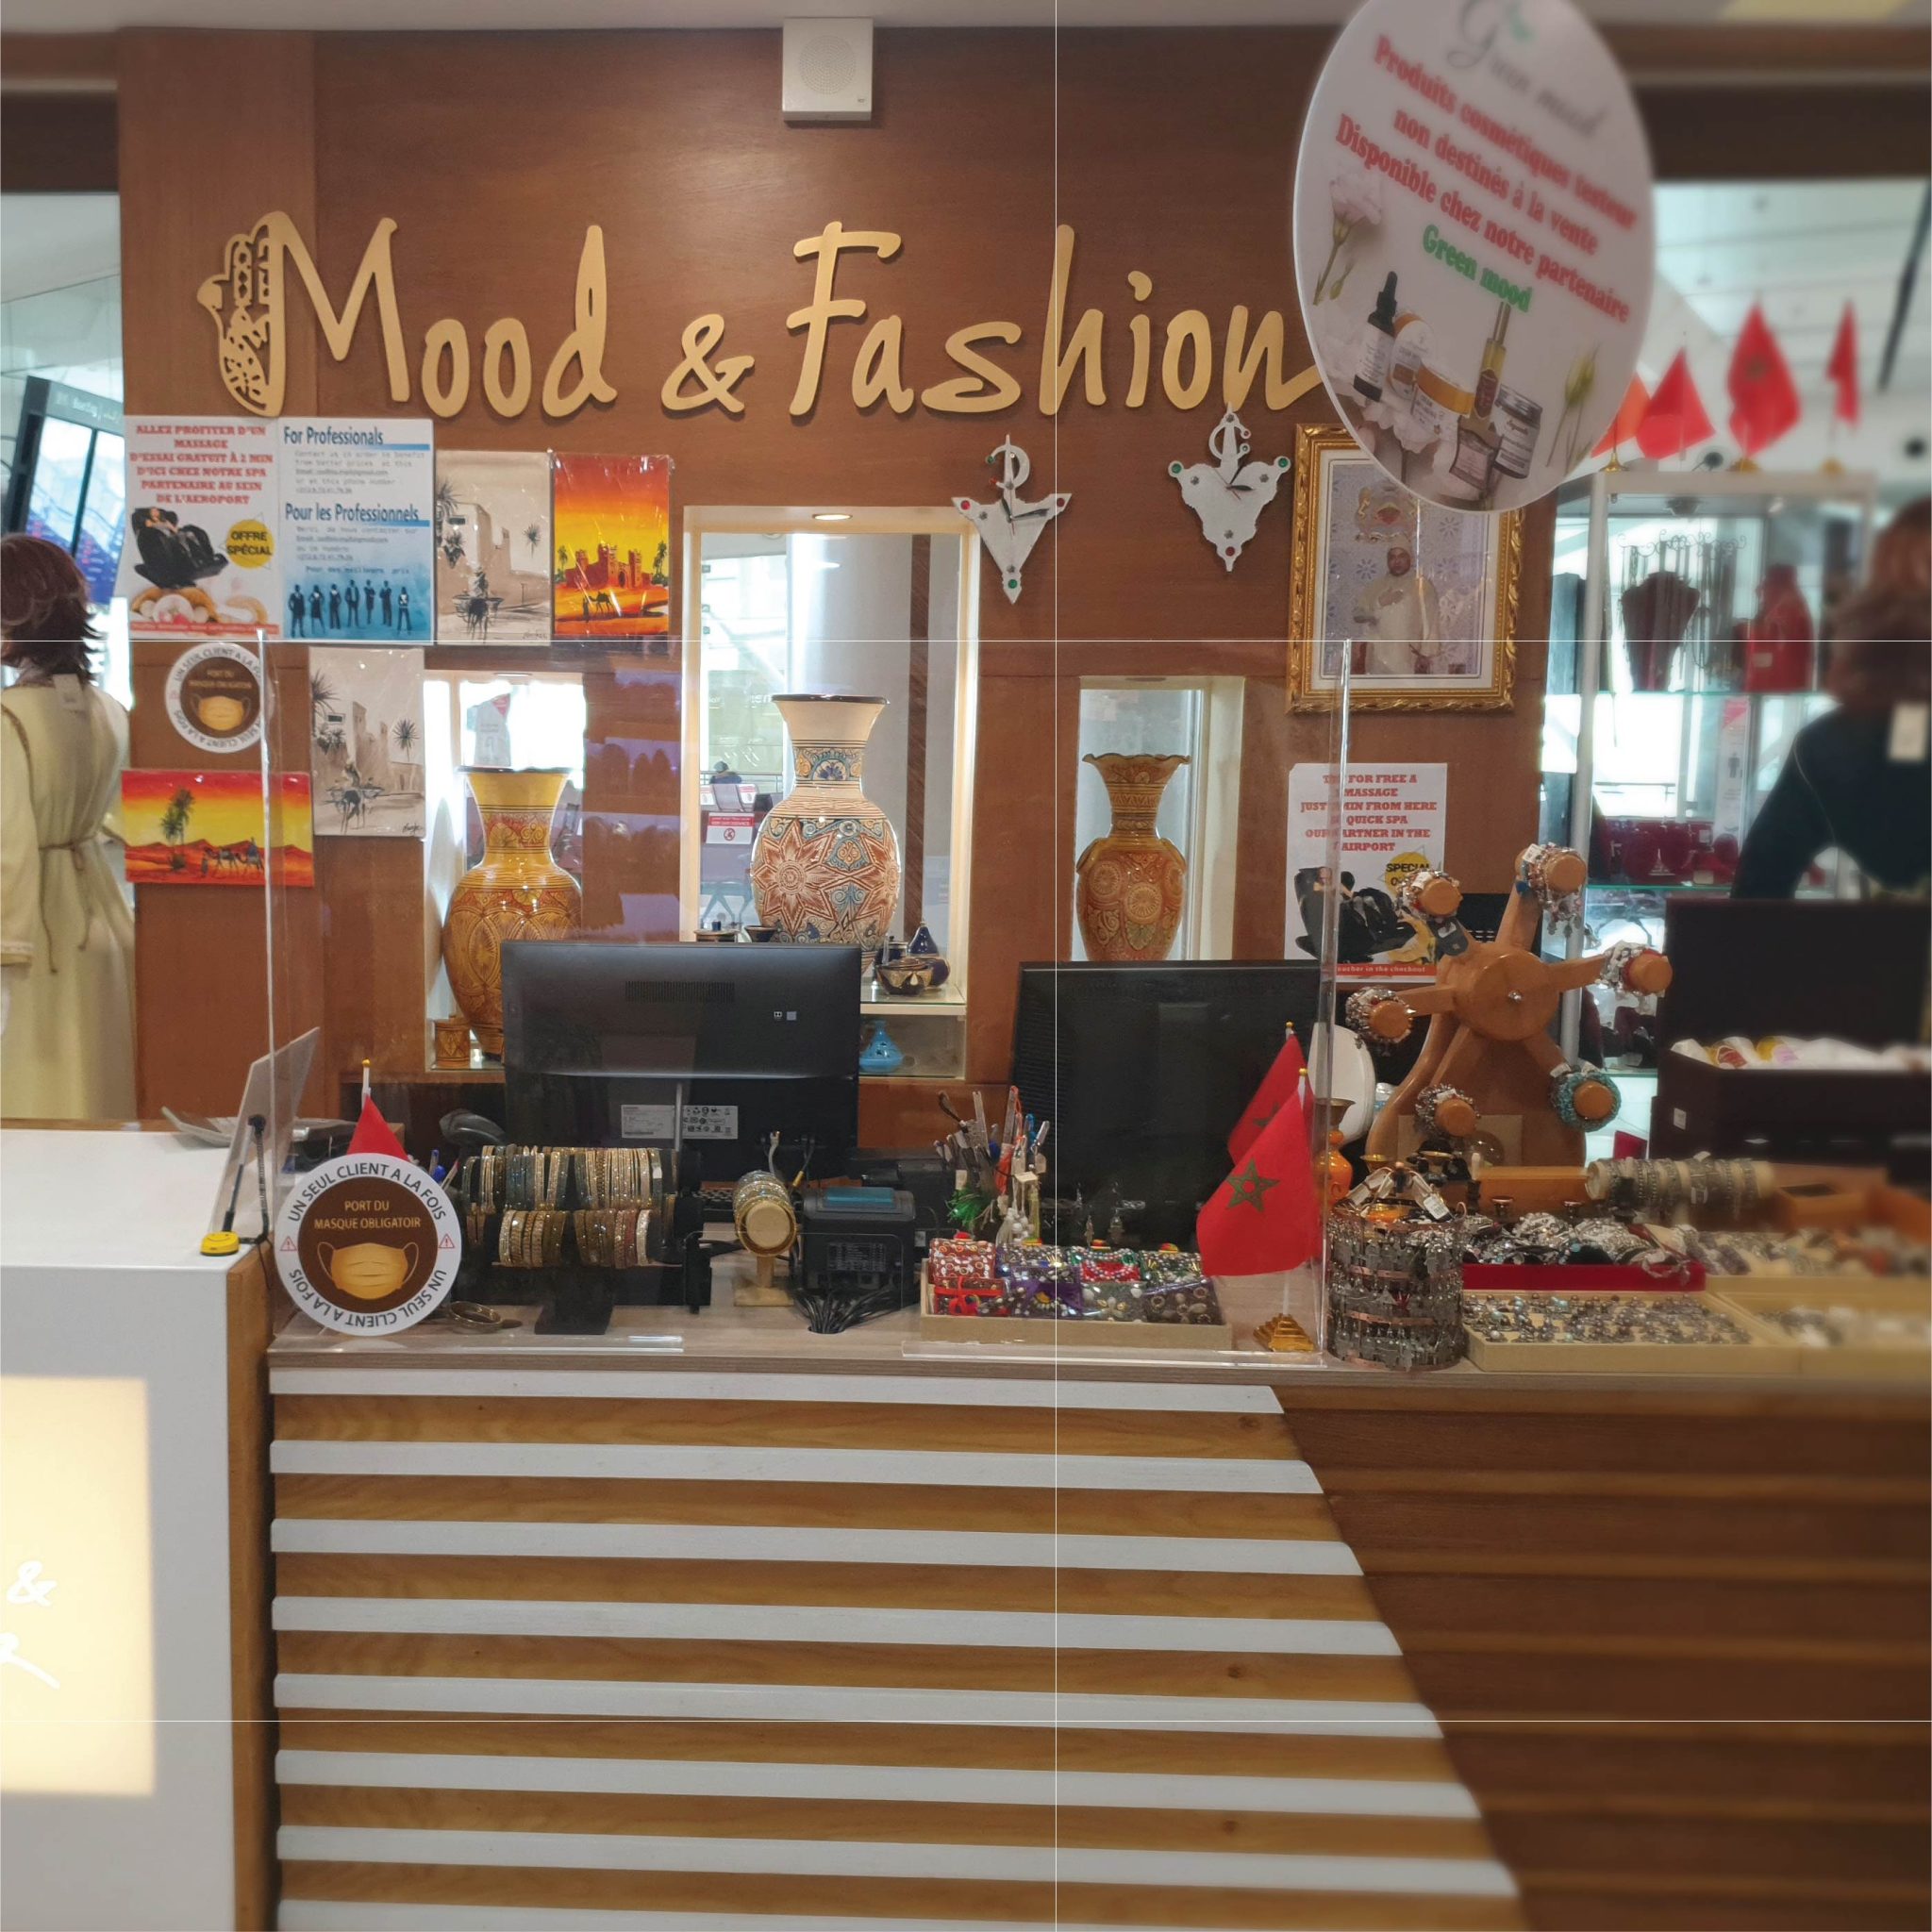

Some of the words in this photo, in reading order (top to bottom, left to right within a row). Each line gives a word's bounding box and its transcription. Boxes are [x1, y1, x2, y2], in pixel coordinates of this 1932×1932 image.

[1374, 33, 1457, 114] Produits
[1394, 108, 1431, 149] non
[1435, 133, 1508, 200] destinés
[1512, 181, 1524, 210] à
[1527, 191, 1544, 223] la
[1551, 209, 1599, 256] vente
[1336, 112, 1437, 204] Disponible
[1441, 191, 1482, 233] chez
[1484, 220, 1535, 265] notre
[1536, 254, 1630, 324] partenaire
[1423, 224, 1477, 281] Green
[1479, 267, 1533, 313] mood
[197, 210, 618, 417] Mood
[661, 314, 755, 413] &
[786, 221, 1323, 416] Fashion
[136, 425, 172, 435] ALLEZ
[175, 425, 235, 435] PROFITER
[284, 426, 303, 444] For
[307, 426, 383, 445] Professionals
[174, 440, 228, 448] MASSAGE
[177, 453, 226, 463] GRATUIT
[169, 467, 199, 475] CHEZ
[203, 467, 242, 476] NOTRE
[245, 468, 266, 477] SPA
[142, 480, 215, 490] PARTENAIRE
[219, 482, 233, 491] AU
[236, 482, 262, 491] SEIN
[157, 494, 172, 503] DE
[285, 503, 312, 520] Pour
[316, 503, 332, 520] les
[335, 503, 419, 522] Professionnels
[231, 531, 267, 541] OFFRE
[1348, 774, 1374, 784] FOR
[1375, 774, 1407, 784] FREE
[1409, 774, 1418, 784] A
[1343, 789, 1399, 797] MASSAGE
[1300, 802, 1327, 813] JUST
[1366, 802, 1401, 810] FROM
[1404, 802, 1438, 810] HERE
[1346, 815, 1384, 825] QUICK
[1386, 816, 1408, 824] SPA
[1391, 829, 1404, 838] IN
[1407, 829, 1431, 838] THE
[1341, 842, 1395, 851] AIRPORT
[288, 1200, 307, 1222] UN
[303, 1174, 335, 1201] SEUL
[337, 1162, 390, 1177] CLIENT
[391, 1168, 401, 1179] A
[404, 1174, 421, 1193] LA
[421, 1190, 446, 1221] FOIS
[344, 1201, 372, 1211] PORT
[375, 1200, 390, 1211] DU
[314, 1218, 358, 1229] MASQUE
[360, 1217, 421, 1229] OBLIGATOIR
[289, 1268, 315, 1300] FOIS
[431, 1269, 447, 1291] UN
[312, 1297, 331, 1316] LA
[399, 1293, 433, 1317] SEUL
[333, 1309, 341, 1321] A
[345, 1314, 397, 1328] CLIENT
[7, 1559, 58, 1607] &
